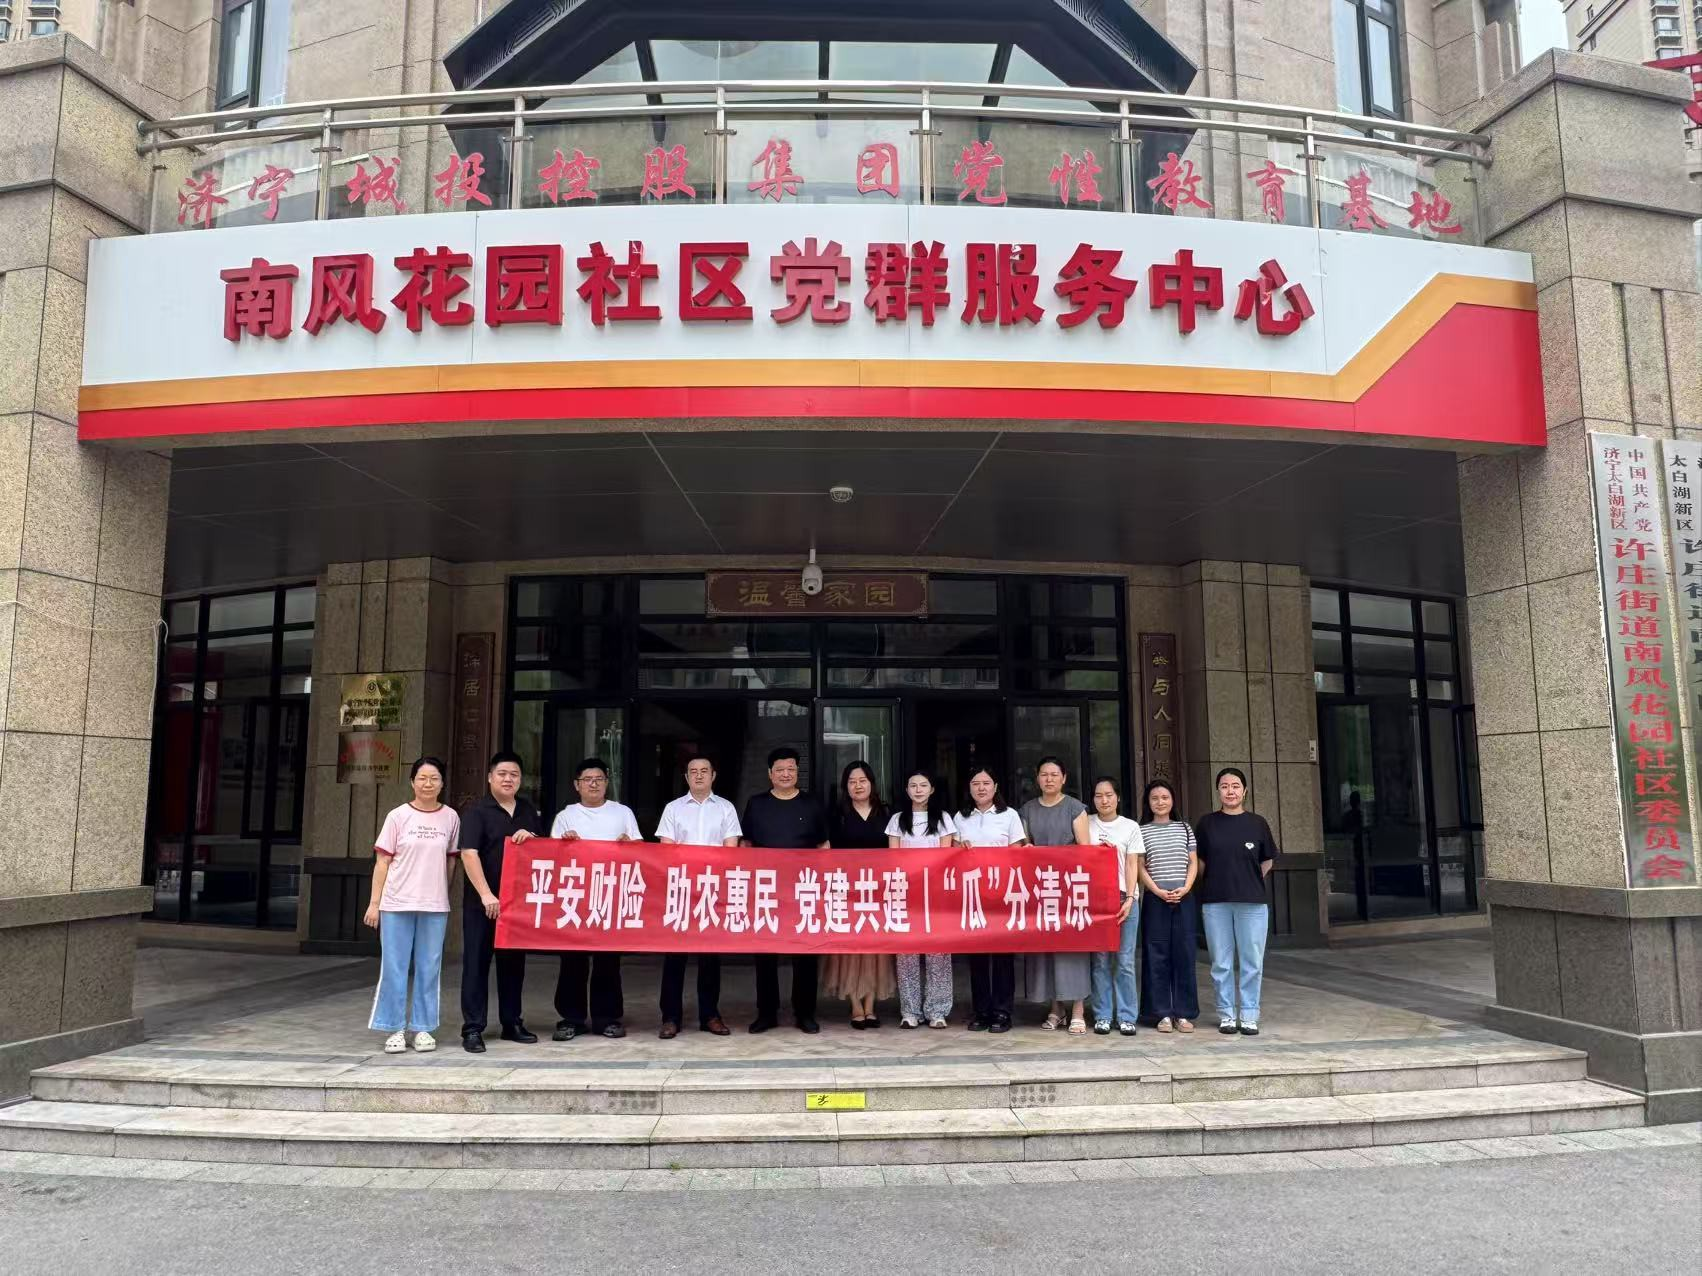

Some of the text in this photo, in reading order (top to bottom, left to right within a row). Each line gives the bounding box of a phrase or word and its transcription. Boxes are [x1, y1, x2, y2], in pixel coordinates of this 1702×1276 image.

[220, 237, 1315, 341] 南风花园社区党群服务中心
[1603, 448, 1627, 531] 济宁太白湖新区
[1628, 449, 1653, 532] 中国共产党
[1670, 454, 1694, 531] 太白湖新区
[738, 580, 896, 608] 温馨家园
[1609, 537, 1686, 881] 许庄街道南风花园社区委员会
[525, 858, 647, 931] 平安财险
[663, 863, 779, 933] 助农惠民
